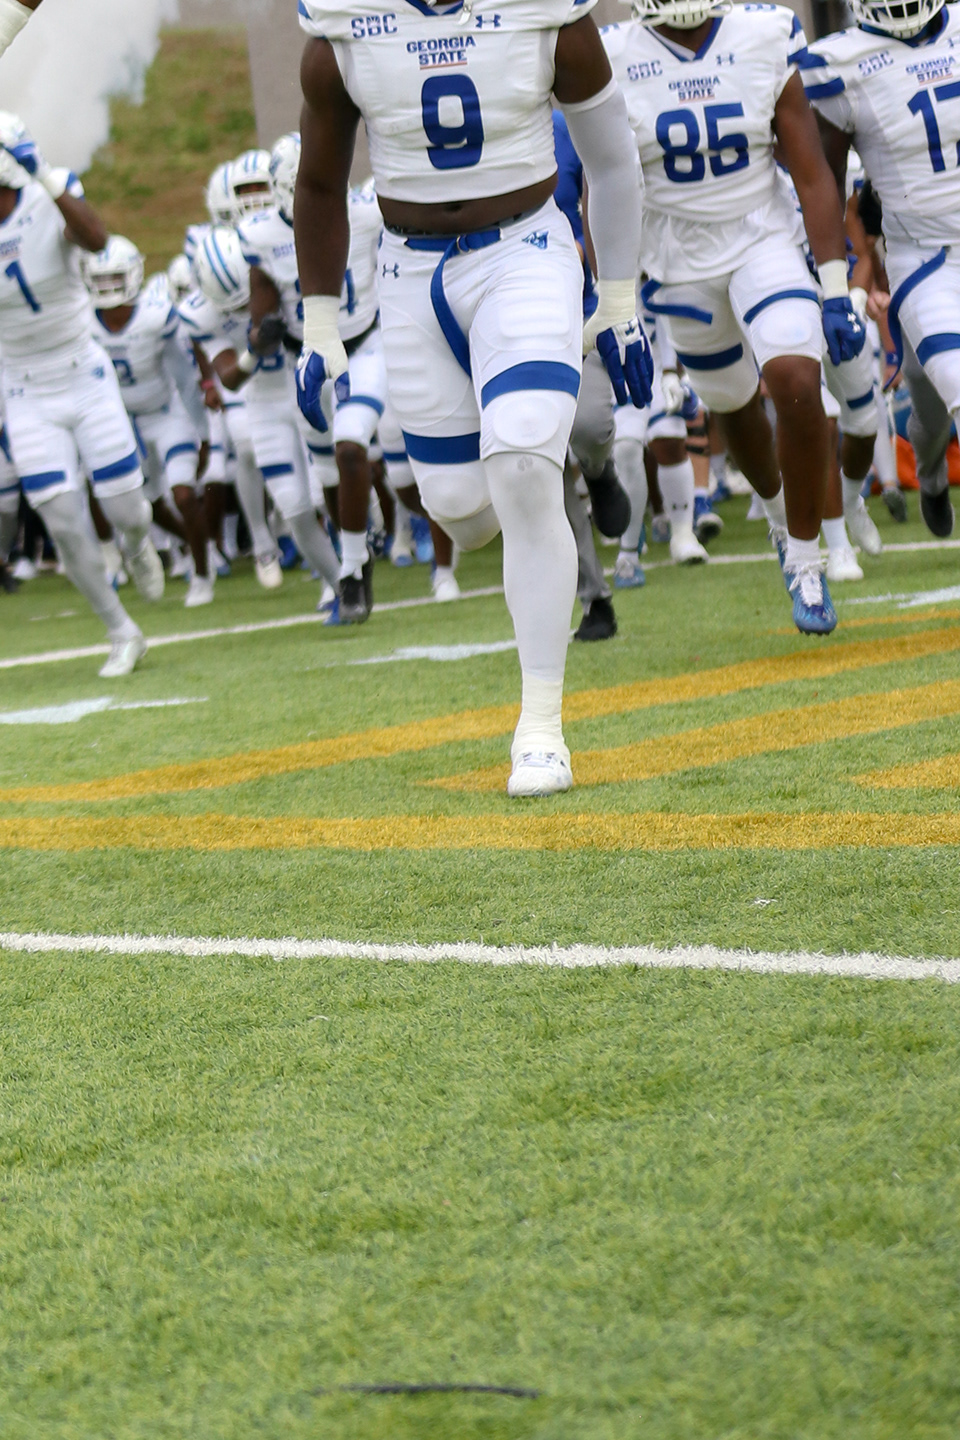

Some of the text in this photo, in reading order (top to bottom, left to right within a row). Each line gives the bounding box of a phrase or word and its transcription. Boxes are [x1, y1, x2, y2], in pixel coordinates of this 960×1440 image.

[351, 13, 398, 39] SBC
[406, 35, 477, 54] GEORGIA
[418, 49, 468, 66] STATE
[905, 55, 957, 75] GEORGIA
[668, 75, 721, 91] GEORGIA
[916, 66, 954, 82] STATE
[677, 87, 716, 101] STATE
[421, 74, 485, 170] 9
[655, 101, 750, 183] 85
[5, 261, 42, 314] 1
